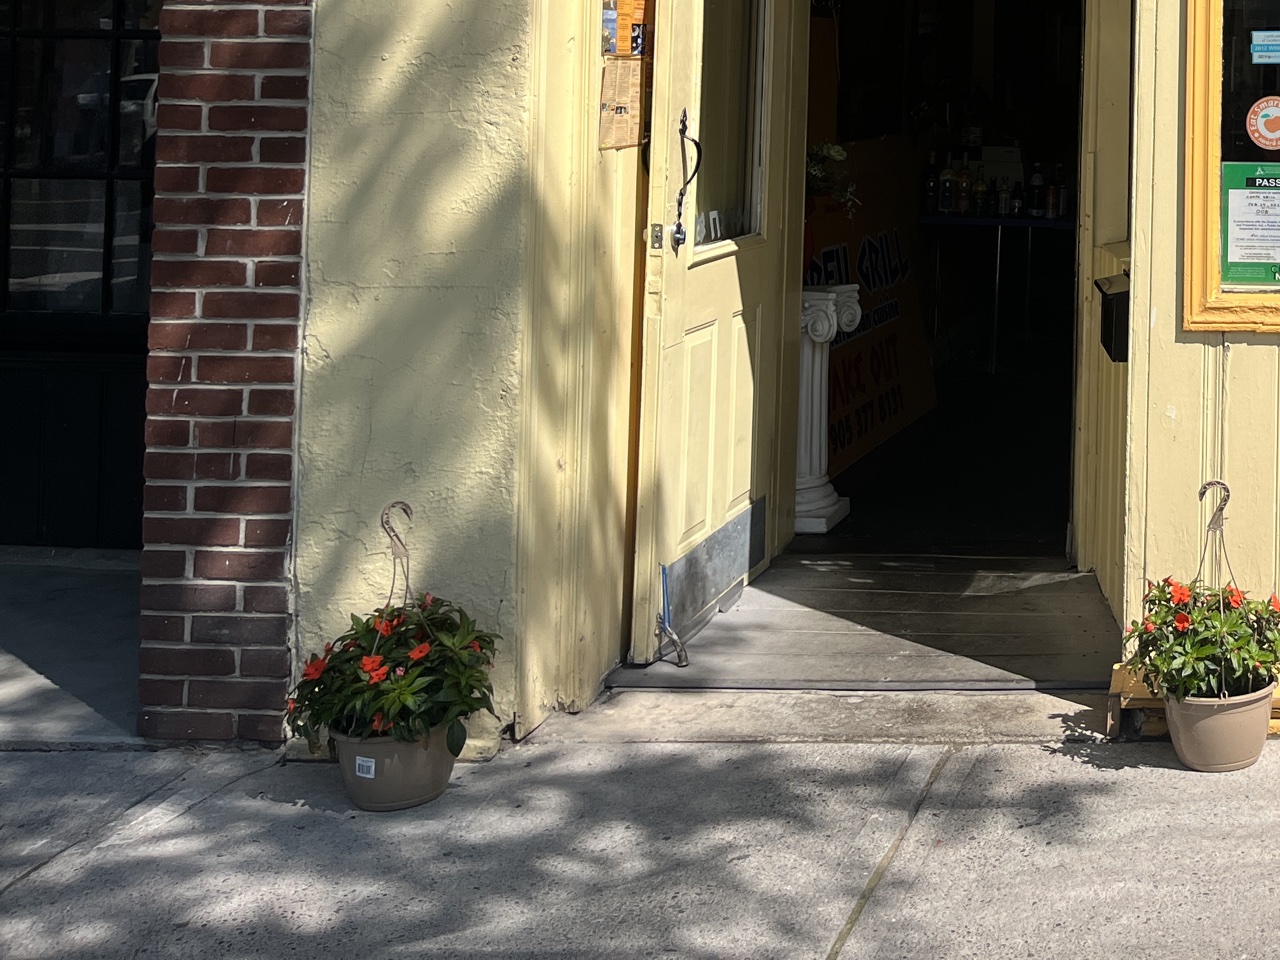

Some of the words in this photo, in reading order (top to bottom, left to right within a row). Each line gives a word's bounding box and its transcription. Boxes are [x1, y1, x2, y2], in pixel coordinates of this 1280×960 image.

[1250, 114, 1258, 131] Eat
[1258, 137, 1277, 146] Award
[857, 228, 910, 295] GRILL
[832, 352, 866, 410] AKE
[870, 333, 900, 387] OUT
[830, 413, 852, 456] 905
[855, 399, 874, 439] 377
[878, 384, 904, 423] 8131
